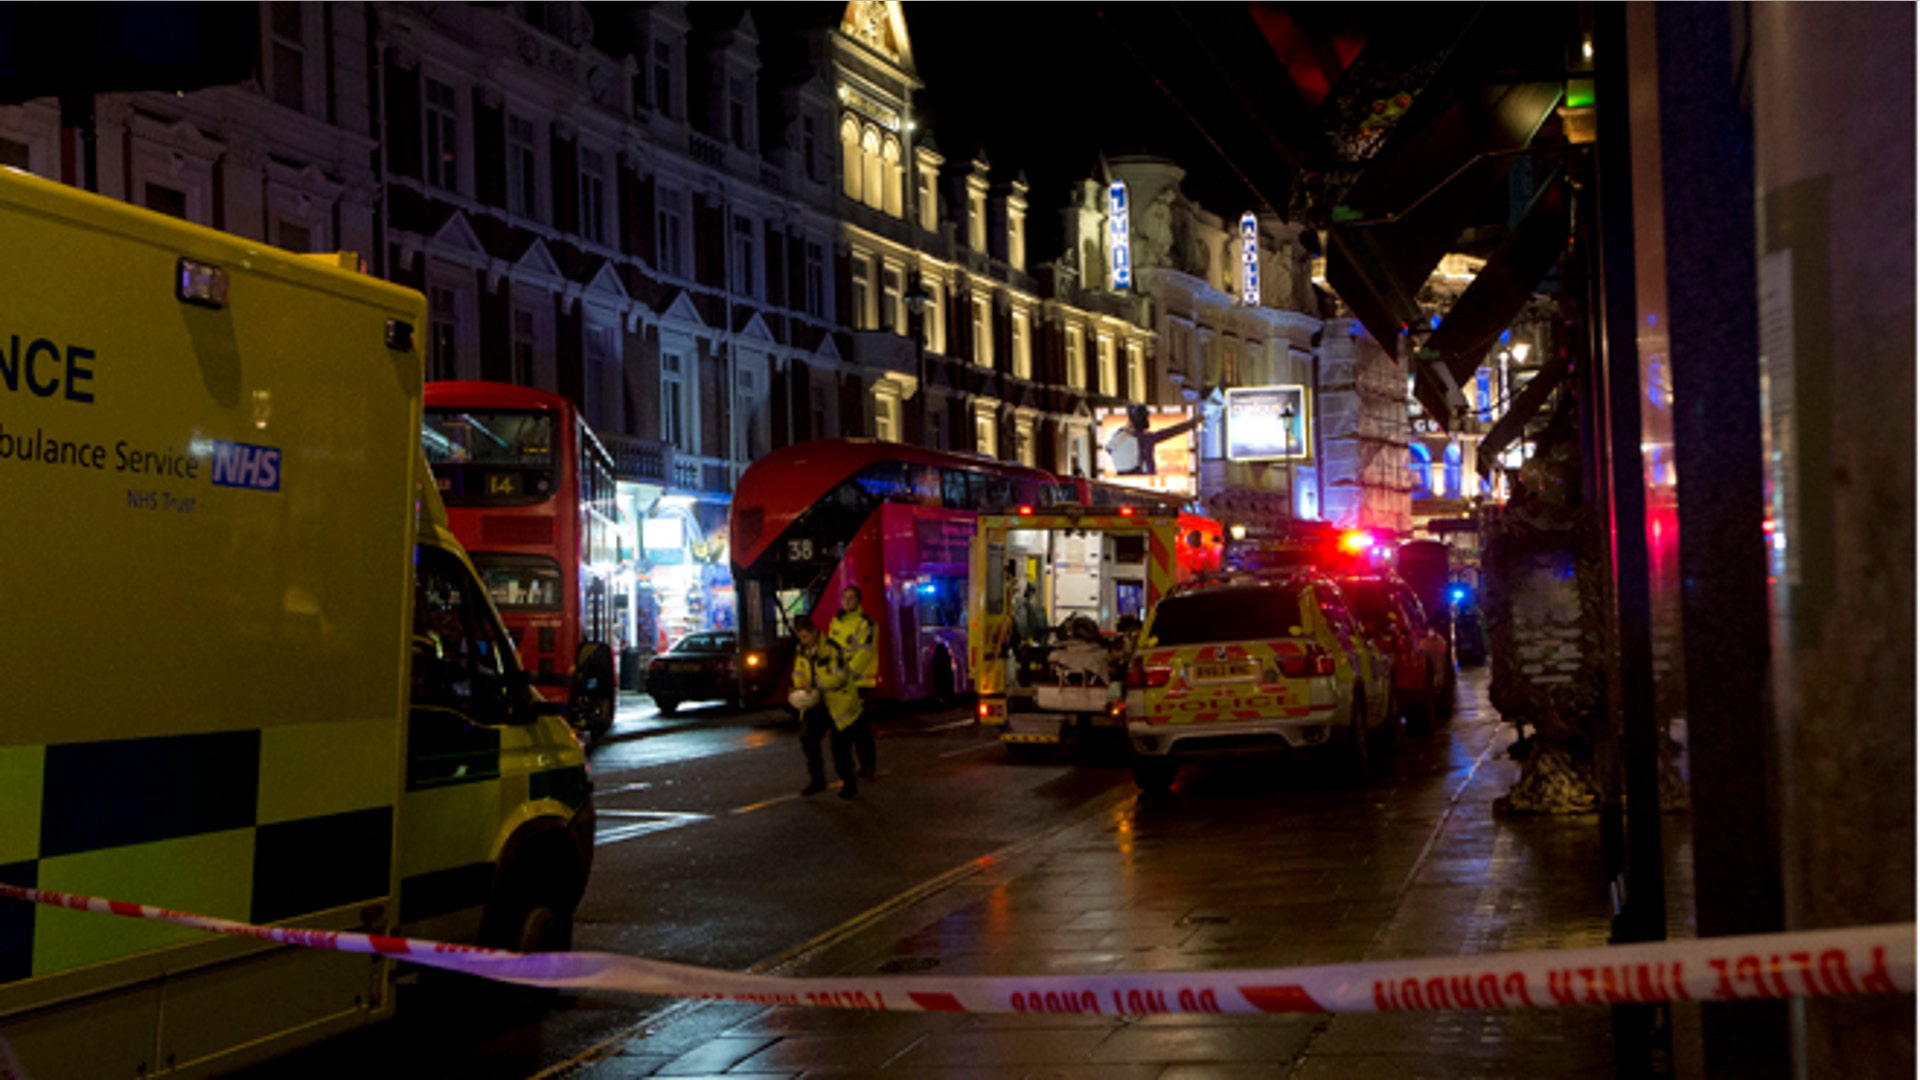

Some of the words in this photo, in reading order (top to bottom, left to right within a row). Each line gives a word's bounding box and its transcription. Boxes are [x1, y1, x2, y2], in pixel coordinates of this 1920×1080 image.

[115, 441, 199, 479] Service
[213, 441, 280, 490] NHS
[491, 476, 515, 496] 14
[127, 490, 158, 511] NHS
[163, 492, 196, 513] Trust
[788, 538, 813, 561] 38
[1154, 694, 1302, 714] POLICE
[1707, 945, 1896, 1000] POLICE
